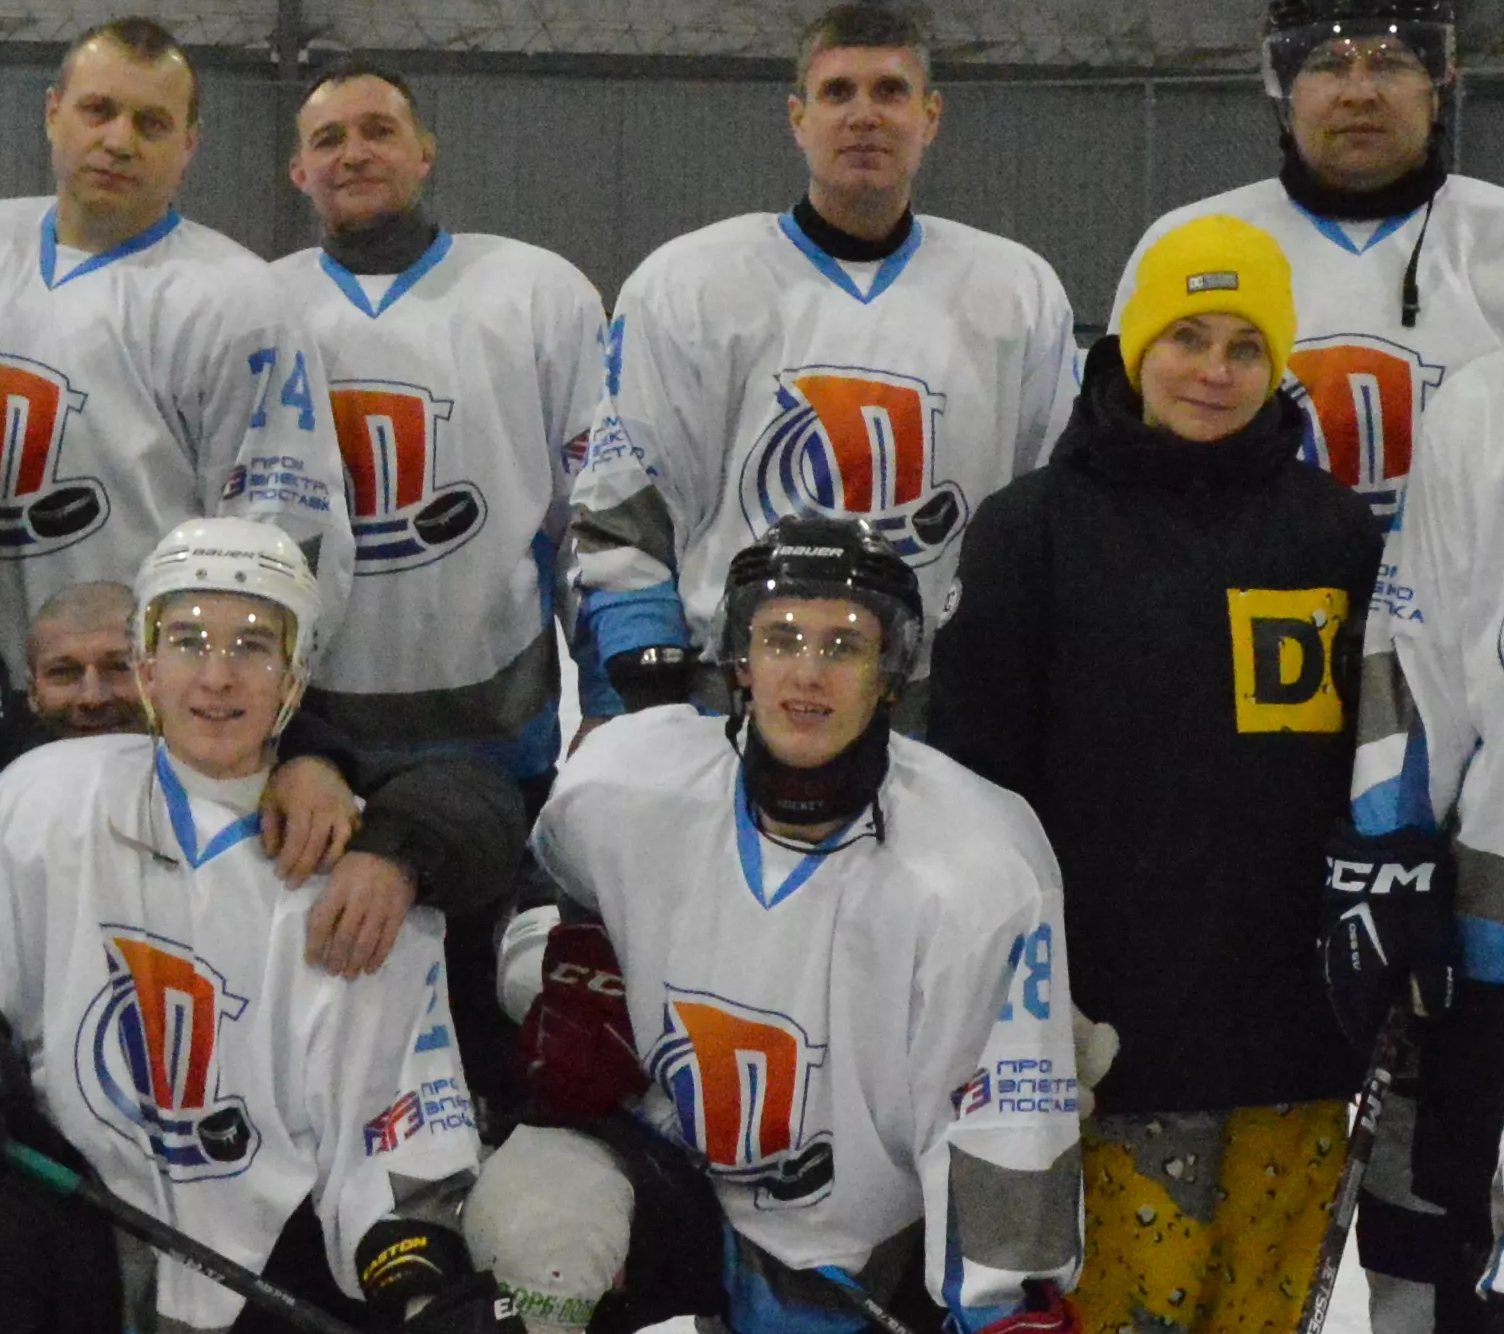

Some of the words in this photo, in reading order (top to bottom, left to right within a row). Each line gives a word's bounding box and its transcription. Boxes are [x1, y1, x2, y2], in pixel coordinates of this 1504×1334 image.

[247, 347, 316, 432] 74
[778, 545, 846, 558] BAUER
[550, 962, 626, 997] CC
